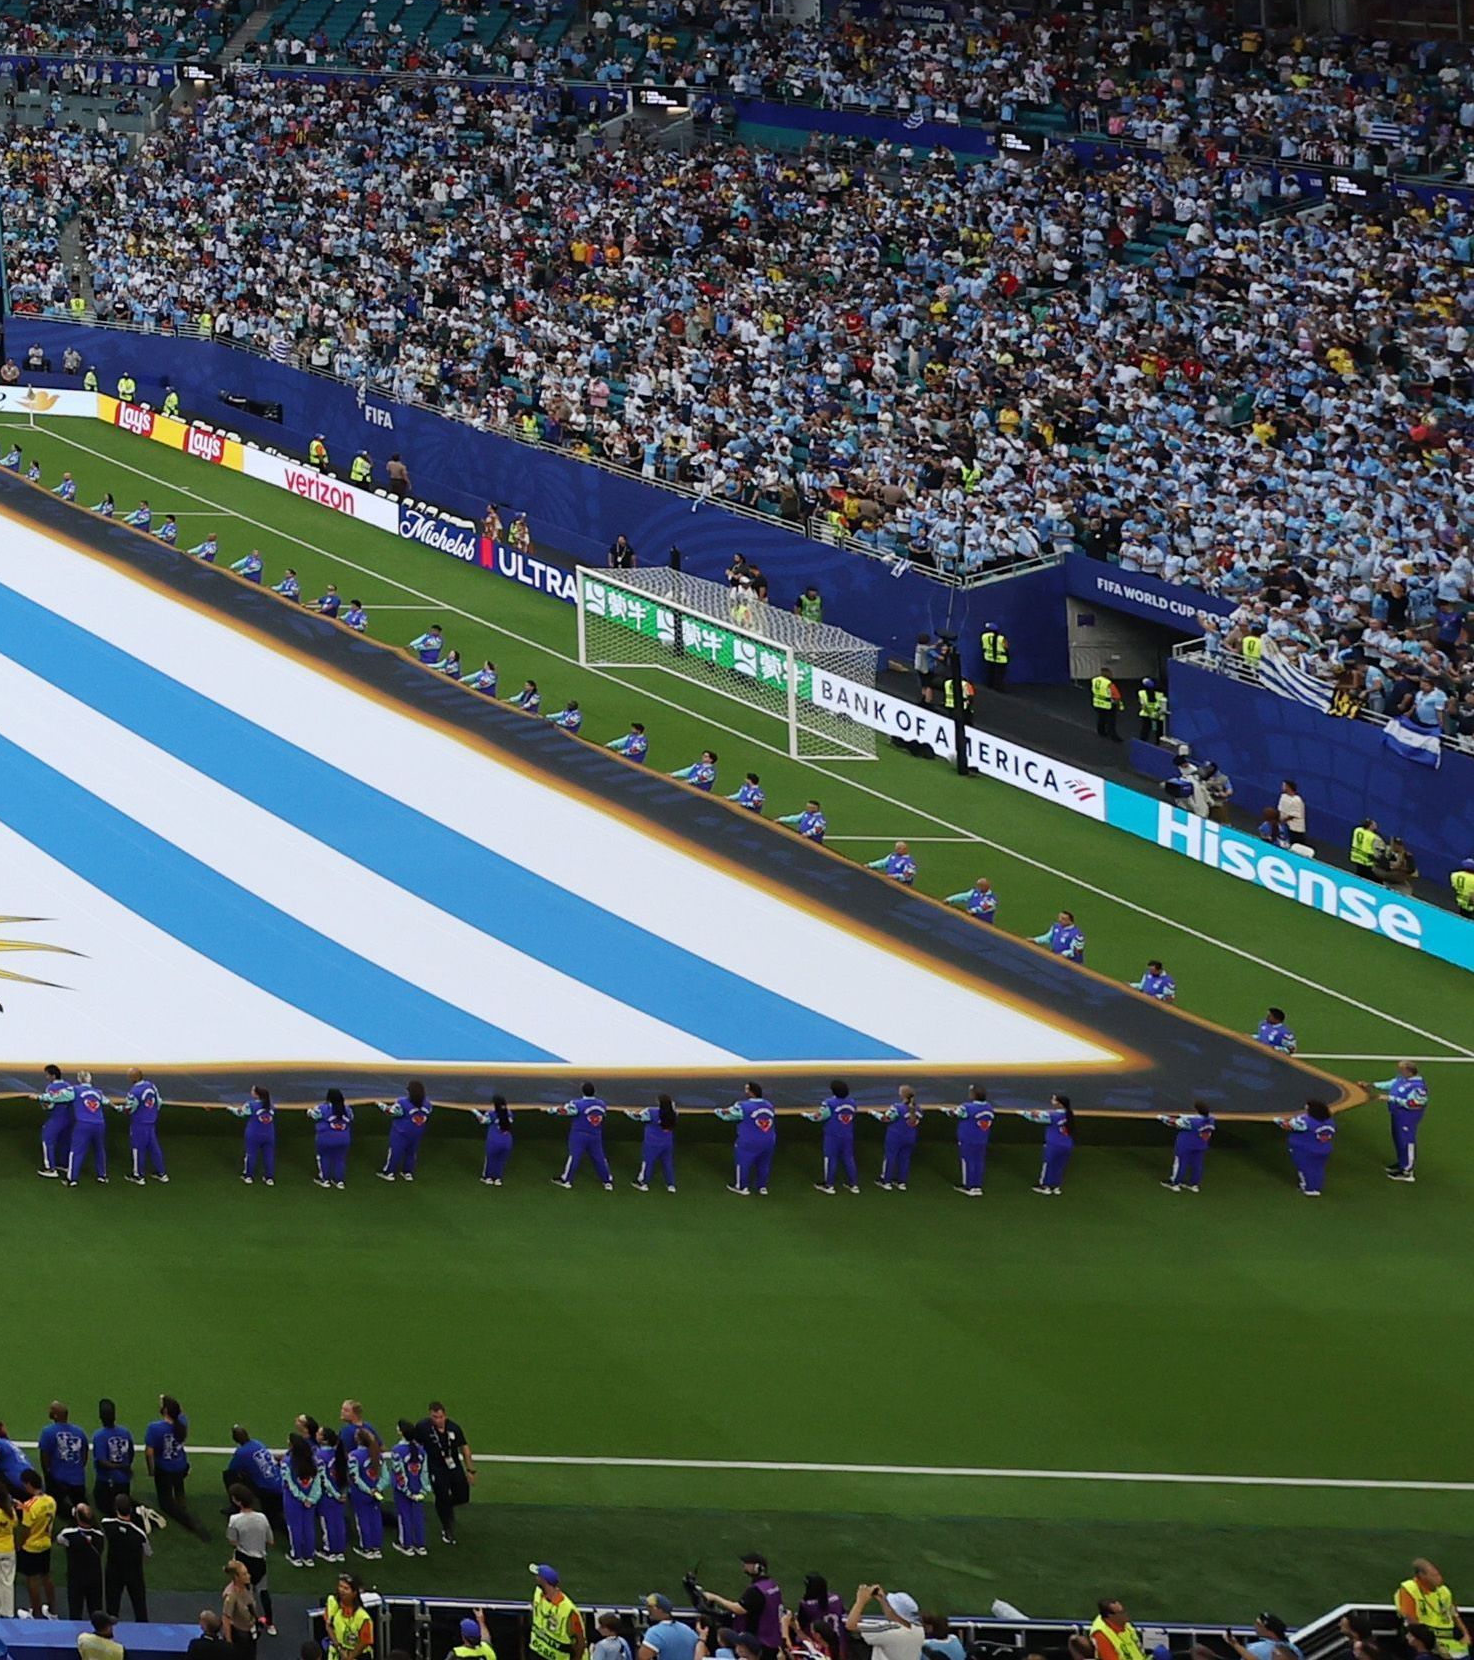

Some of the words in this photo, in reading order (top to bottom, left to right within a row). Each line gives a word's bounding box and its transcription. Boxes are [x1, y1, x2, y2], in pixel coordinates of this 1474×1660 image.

[118, 404, 152, 434] Lay's
[364, 404, 394, 430] FIFA
[186, 428, 223, 462] Lay's
[284, 467, 356, 518] verizon
[399, 506, 476, 561] Michelob
[498, 546, 577, 601] ULTRA
[1097, 577, 1124, 597] FIFA
[1124, 585, 1168, 611] WORLD
[1169, 599, 1196, 618] CUP
[820, 676, 887, 726] BANK
[896, 707, 927, 737] OF
[1157, 802, 1423, 950] Hisense
